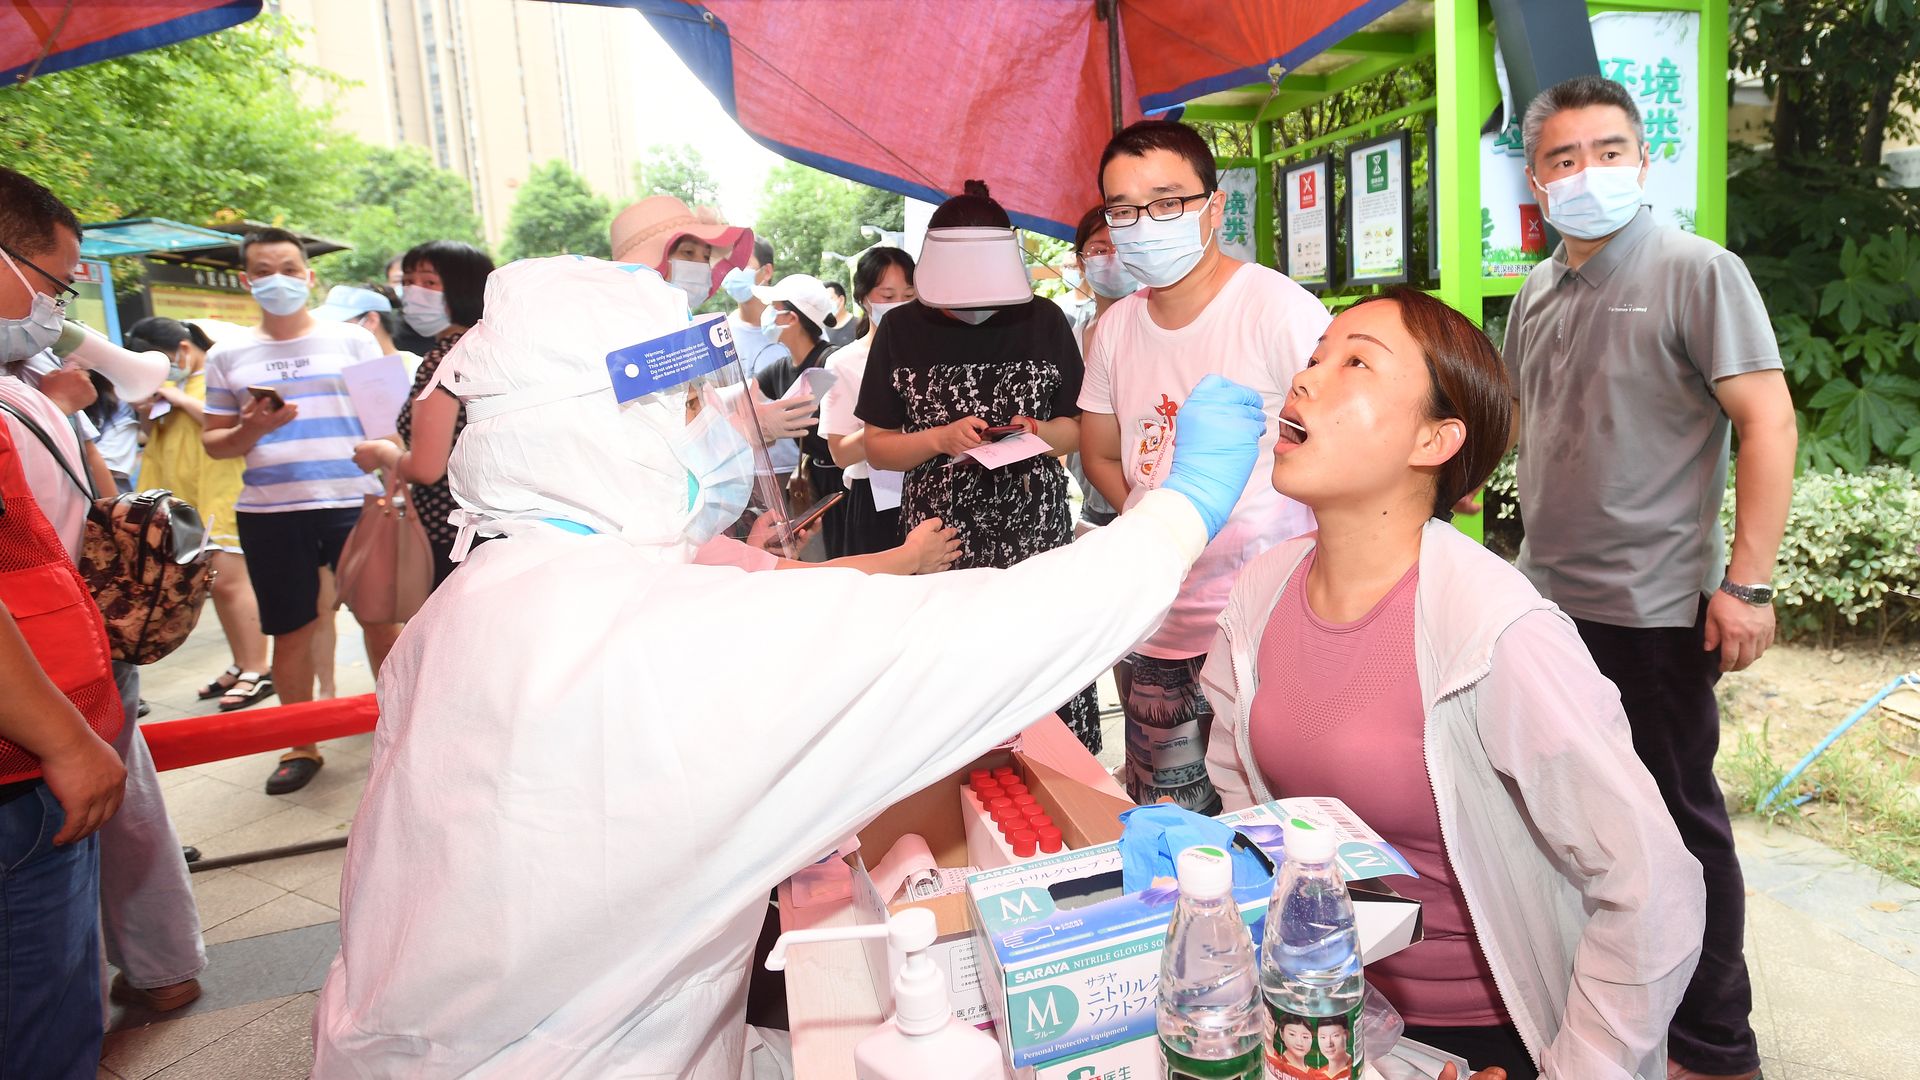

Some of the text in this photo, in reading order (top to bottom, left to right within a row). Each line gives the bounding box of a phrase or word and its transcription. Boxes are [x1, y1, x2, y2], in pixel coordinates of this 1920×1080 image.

[1222, 215, 1248, 243] 类
[648, 362, 659, 370] This
[658, 359, 672, 368] shield
[656, 355, 666, 363] only
[664, 368, 676, 377] flame
[975, 865, 1025, 882] SARAYA
[1028, 856, 1062, 870] NITRILE
[1063, 850, 1093, 862] GLOVES
[999, 890, 1042, 921] M
[1015, 961, 1070, 984] SARAYA
[1073, 952, 1111, 969] NITRILE
[1113, 943, 1149, 959] GLOVES
[1084, 971, 1118, 989] サラヤ
[1026, 991, 1063, 1033] M
[1023, 1025, 1129, 1061] Personal Protective Equipment
[1034, 1030, 1056, 1040] ブルー
[1089, 1066, 1132, 1080] 医生
